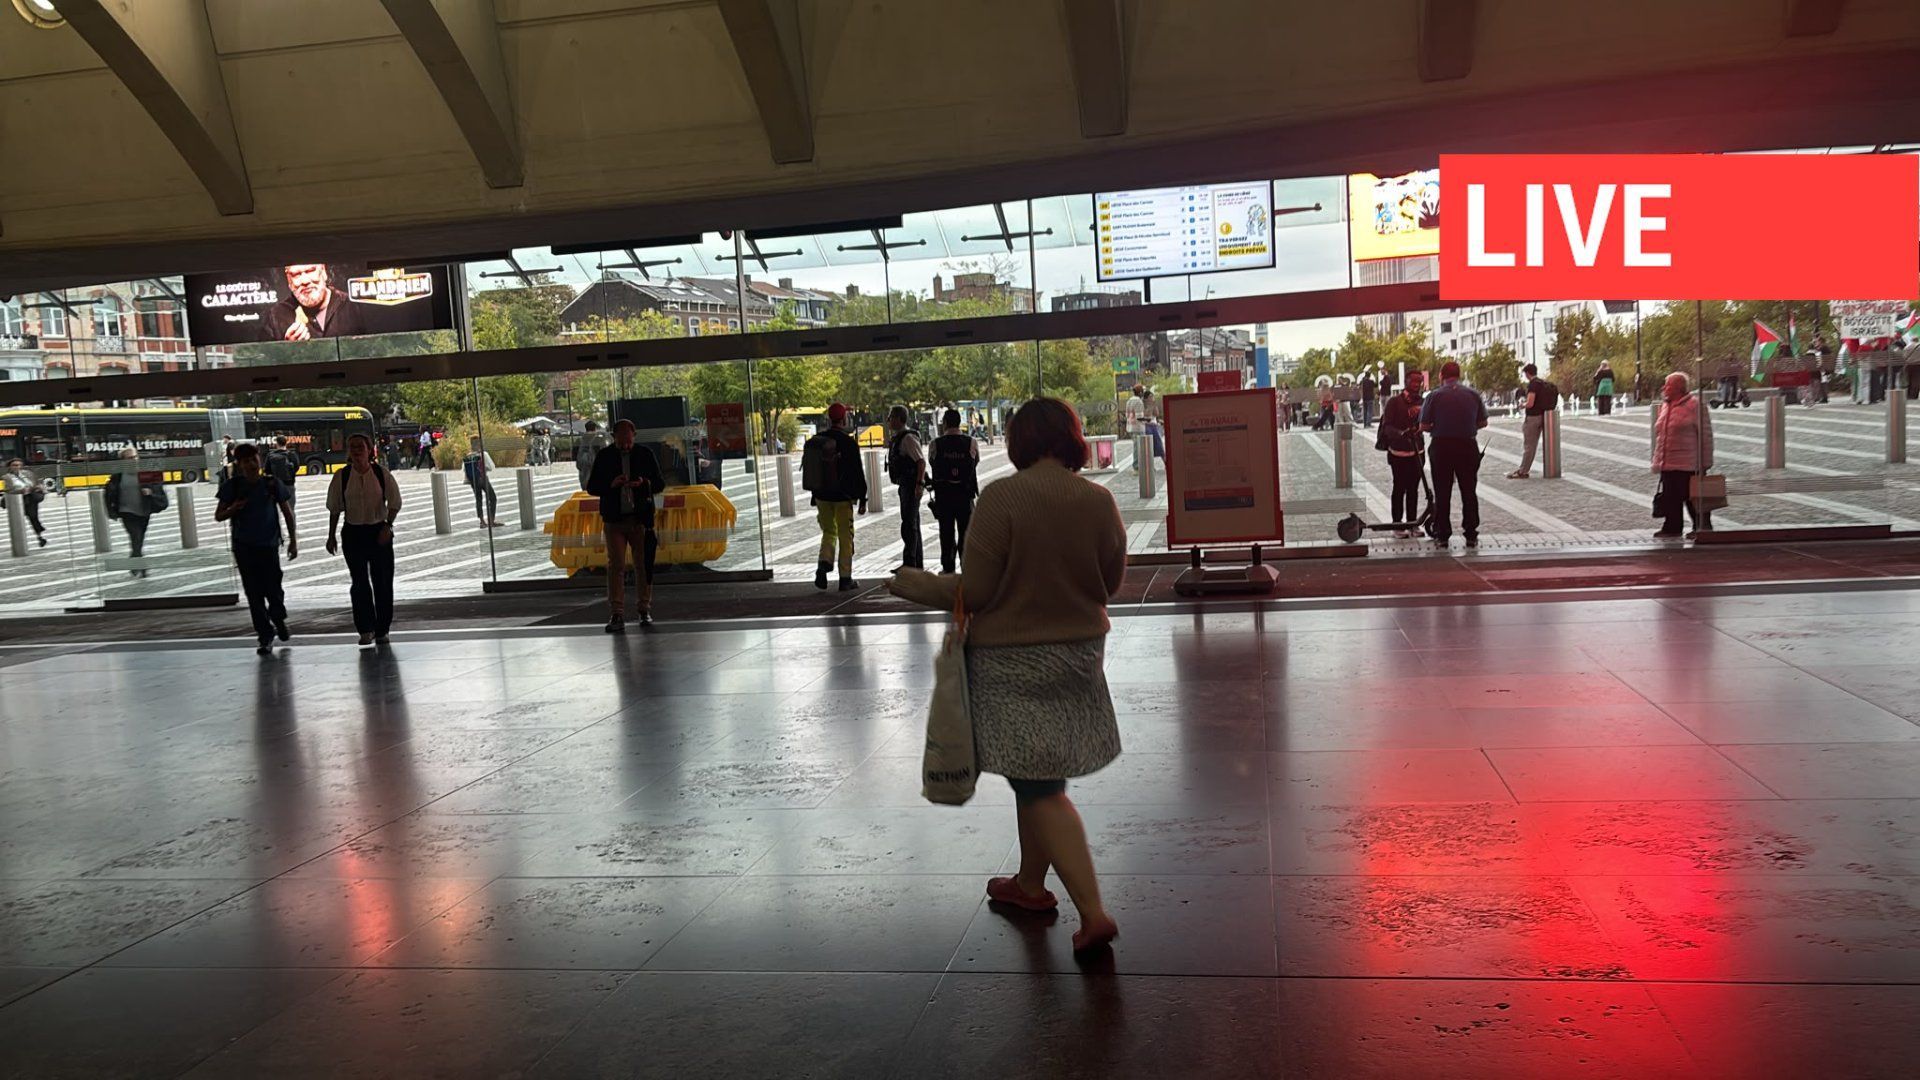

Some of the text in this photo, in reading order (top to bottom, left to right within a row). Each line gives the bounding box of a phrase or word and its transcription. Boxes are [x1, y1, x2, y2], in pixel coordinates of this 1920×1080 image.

[216, 285, 226, 293] LE
[226, 282, 248, 292] GOÛT
[350, 278, 430, 297] FLANDRIEN
[202, 290, 278, 307] CARACTÈRE
[1844, 315, 1892, 326] BOYCOTTE
[1850, 326, 1884, 336] ISRAEL
[1200, 415, 1238, 426] TRAVAUX
[86, 442, 124, 452] PASSEZ
[136, 439, 202, 450] L'ÉLECTRIQUE
